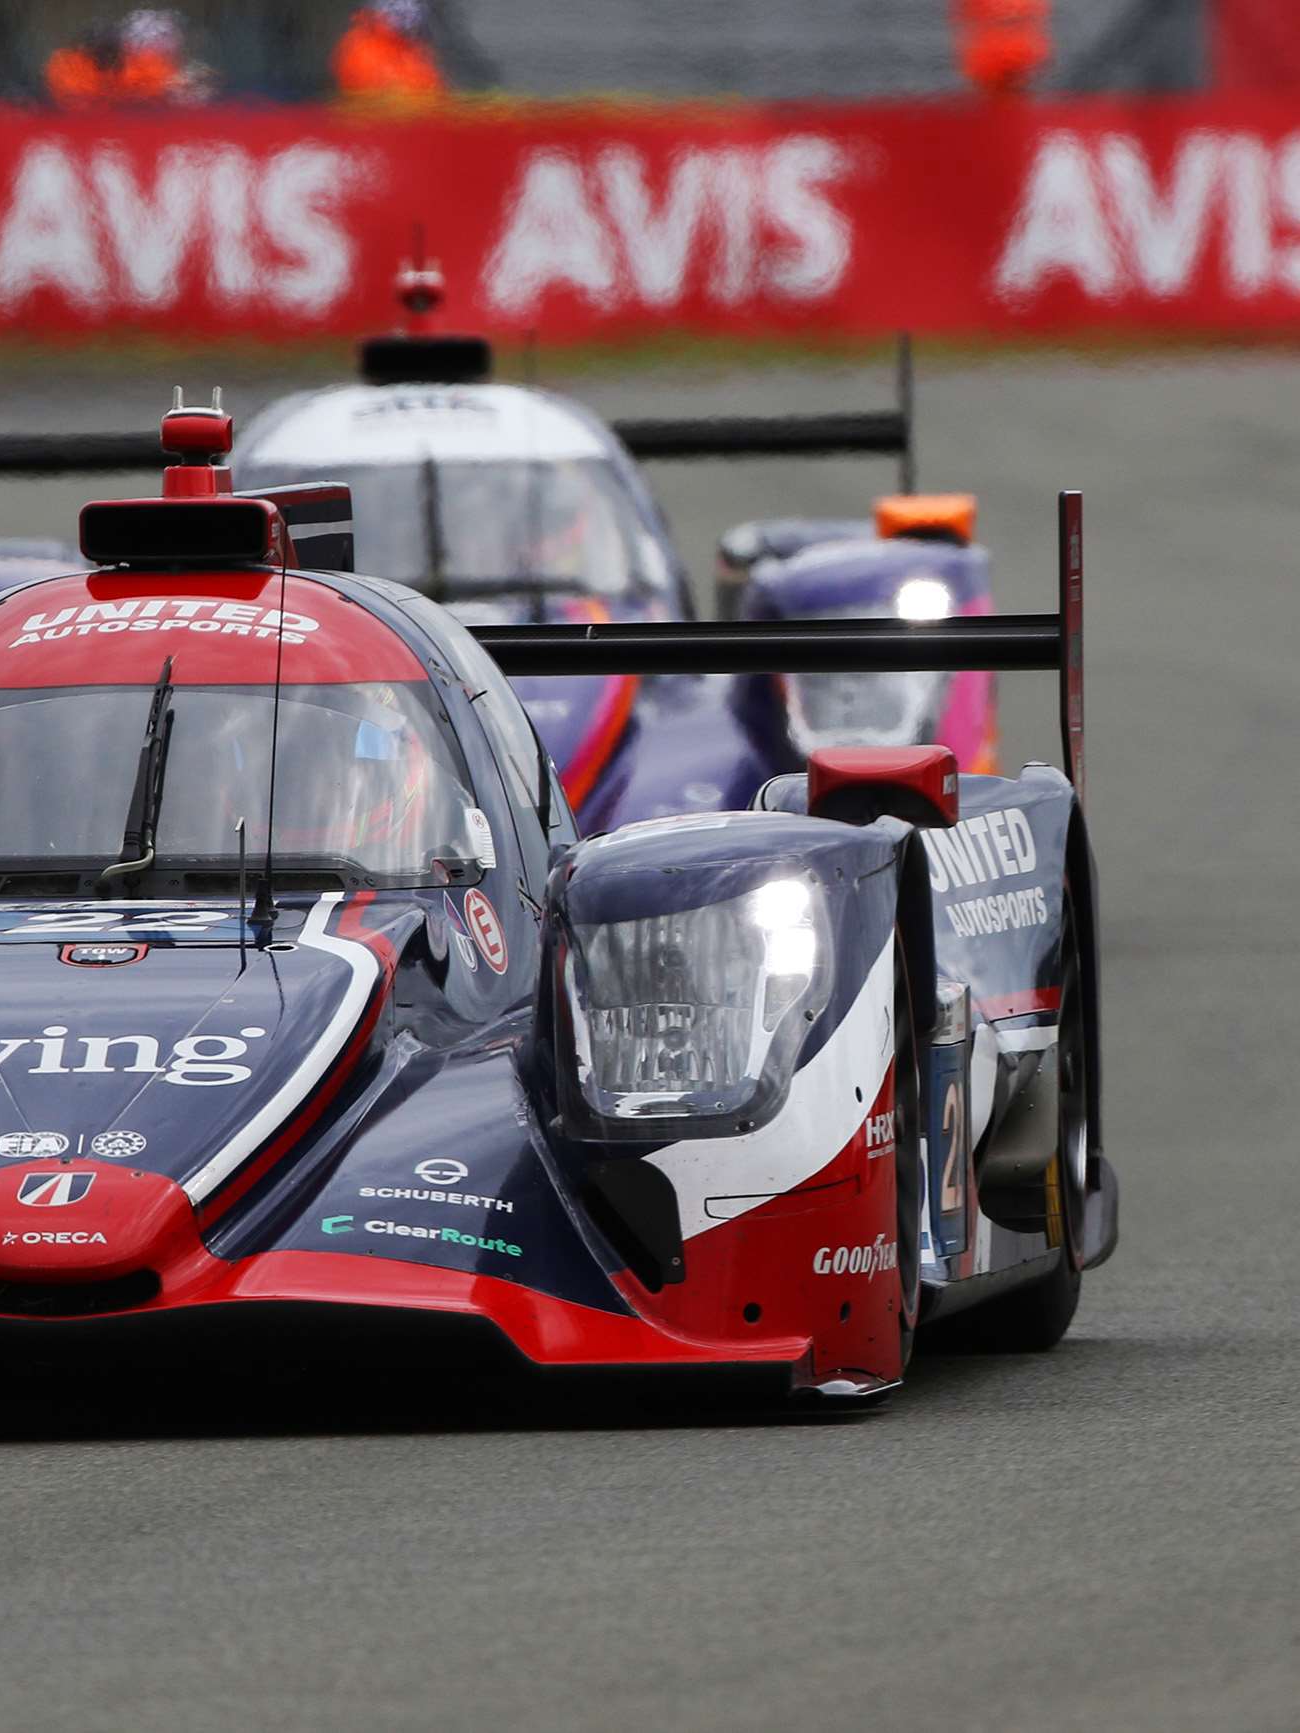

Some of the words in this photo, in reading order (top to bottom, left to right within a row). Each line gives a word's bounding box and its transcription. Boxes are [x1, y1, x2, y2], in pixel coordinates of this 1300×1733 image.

[484, 133, 858, 312] AVIS
[994, 128, 1300, 308] AVI
[21, 600, 320, 632] UNITED
[7, 618, 308, 649] AUTOSPORTS
[919, 807, 1037, 893] UNITED
[1, 911, 230, 934] 22
[946, 886, 1048, 938] AUTOSPORTS
[78, 947, 129, 955] TOW
[0, 1137, 62, 1156] FIA
[358, 1187, 514, 1214] SCHUBERTH
[21, 1231, 108, 1245] ORECA
[364, 1219, 524, 1257] ClearRoute
[813, 1233, 897, 1283] GOODYEA
